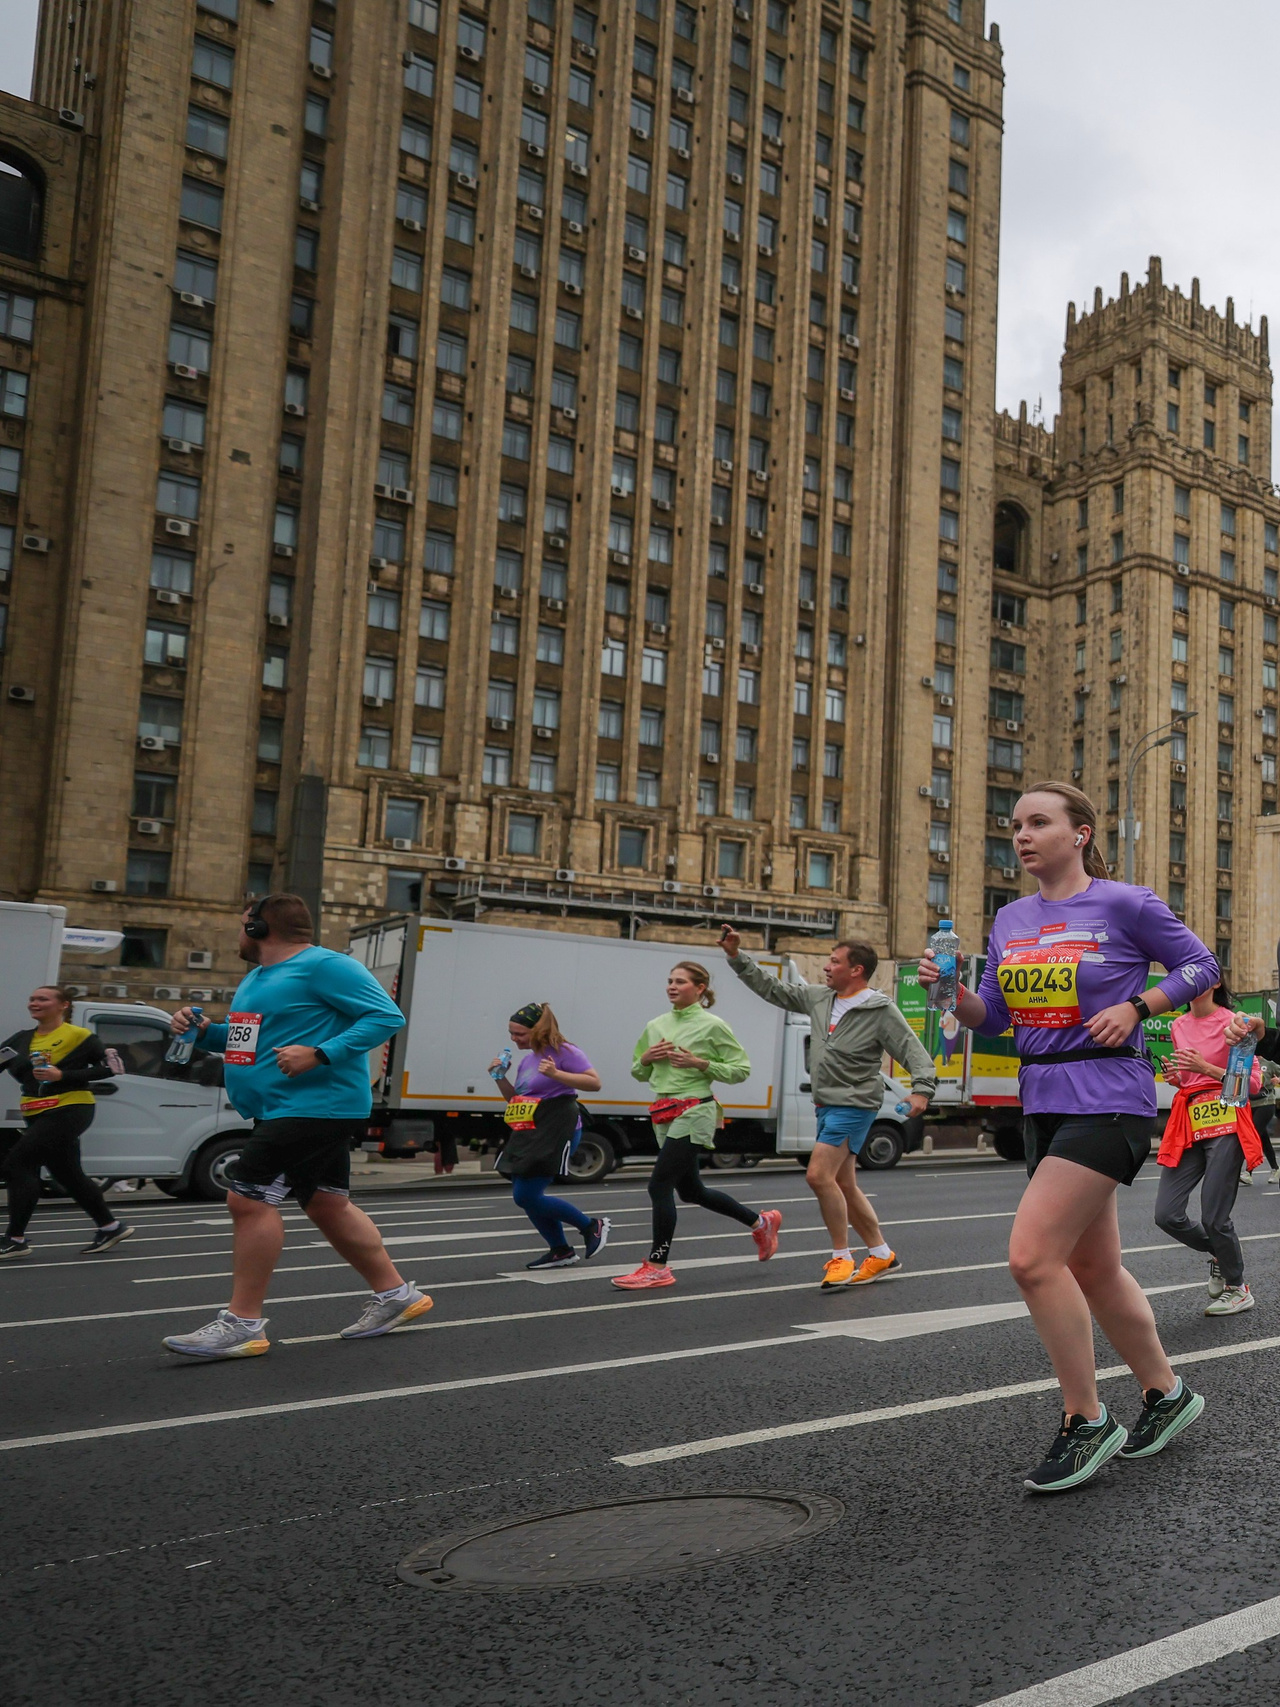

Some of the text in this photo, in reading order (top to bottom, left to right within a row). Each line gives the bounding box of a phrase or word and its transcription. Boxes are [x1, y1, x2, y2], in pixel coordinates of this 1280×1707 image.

[1047, 956, 1056, 964] 10
[1000, 967, 1073, 993] 20243
[1014, 1011, 1023, 1024] G
[506, 1105, 534, 1116] 22181
[1193, 1102, 1228, 1121] 8259
[1194, 1131, 1201, 1140] G
